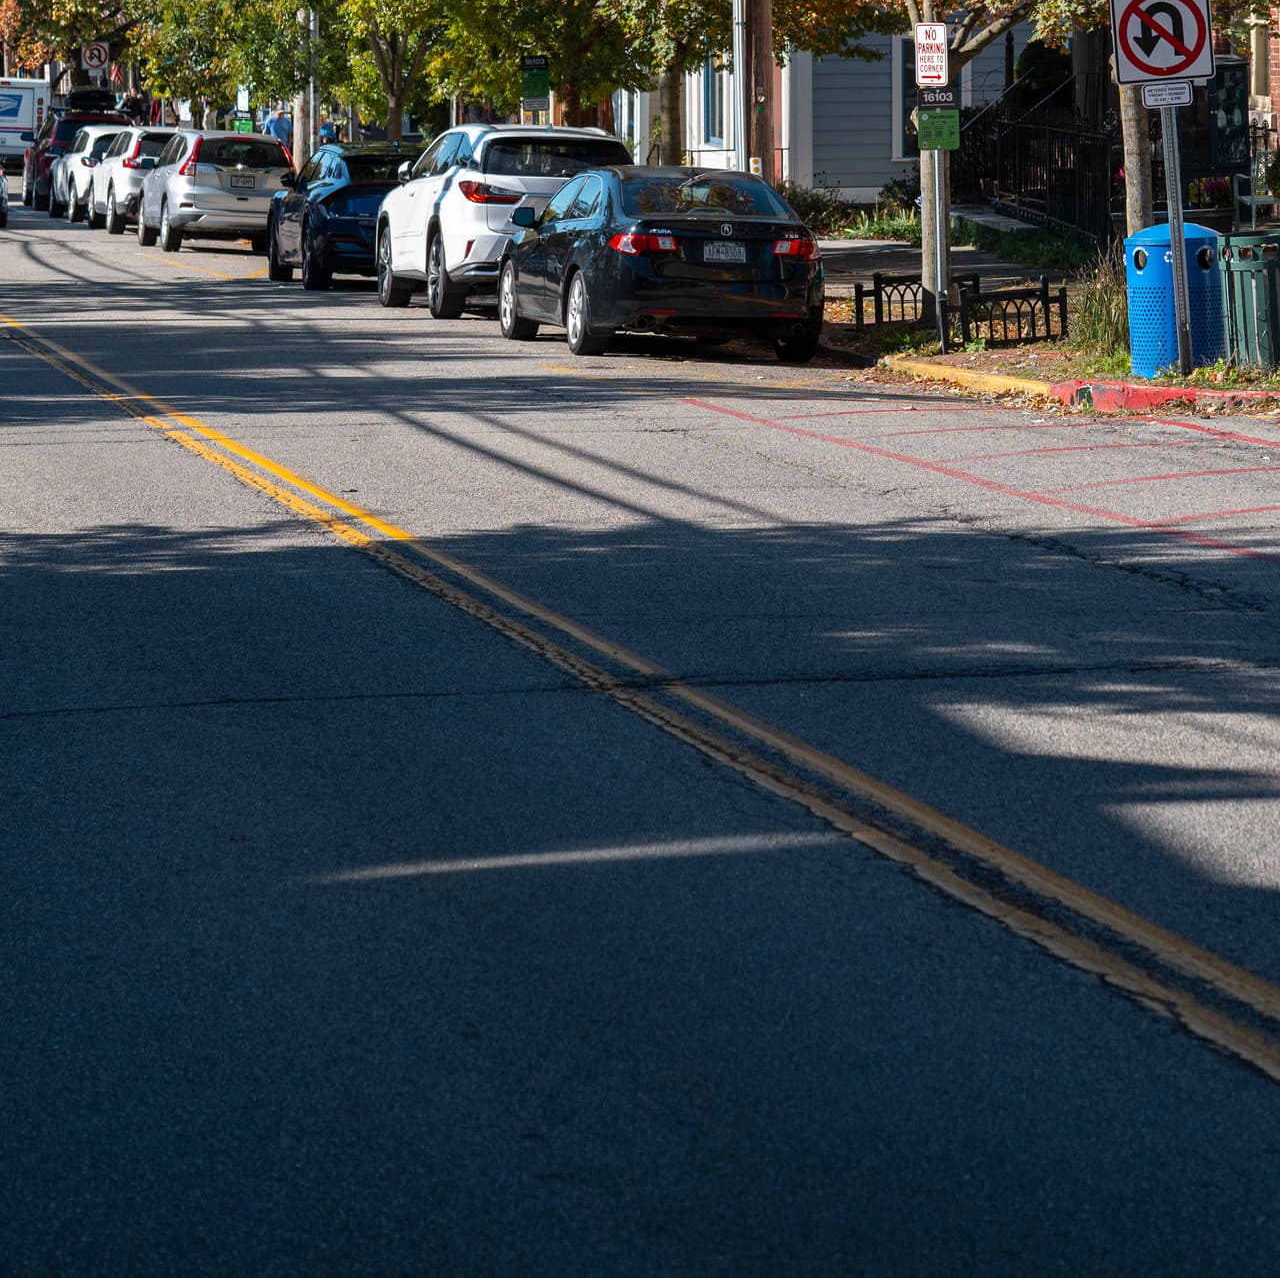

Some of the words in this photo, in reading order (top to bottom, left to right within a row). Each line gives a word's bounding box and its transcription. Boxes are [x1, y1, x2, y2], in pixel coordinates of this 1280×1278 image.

[925, 29, 937, 41] NO
[918, 43, 944, 54] PARKING
[919, 55, 934, 63] HERE
[936, 55, 944, 63] TO
[920, 64, 944, 72] CORNER
[923, 92, 953, 102] 16103
